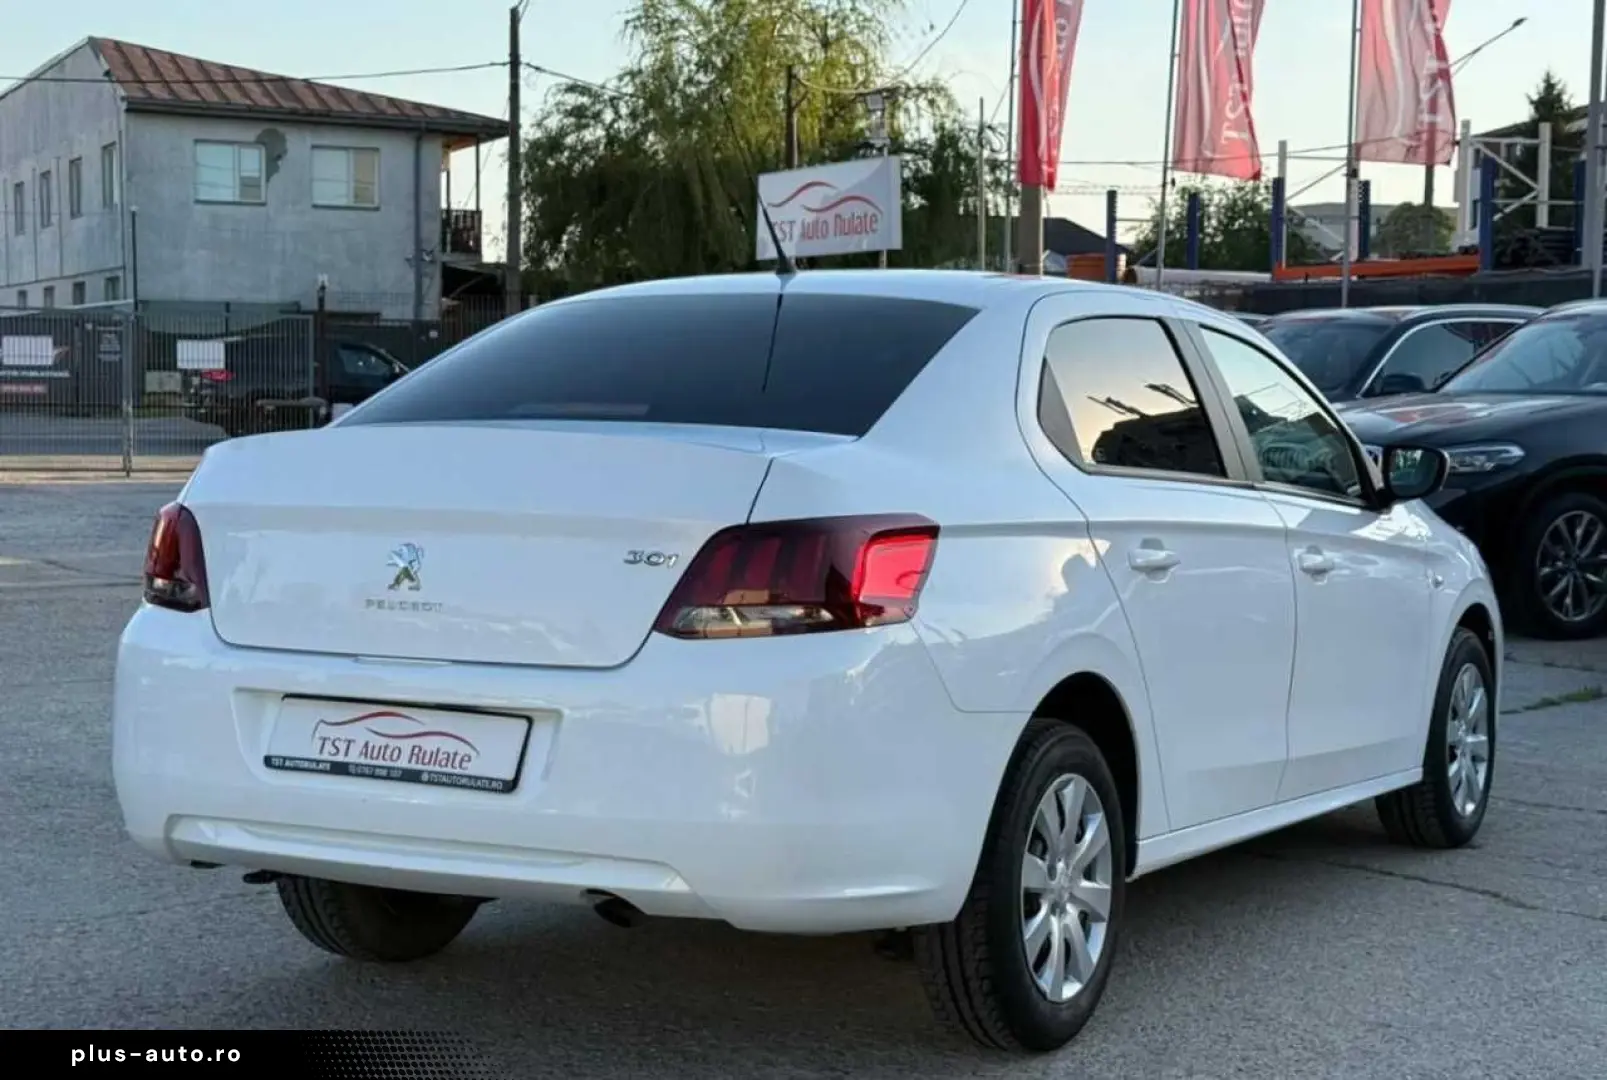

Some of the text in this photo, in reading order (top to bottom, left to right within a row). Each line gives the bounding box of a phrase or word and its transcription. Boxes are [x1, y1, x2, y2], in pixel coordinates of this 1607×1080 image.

[801, 217, 830, 241] Auto
[834, 212, 879, 237] Rulate
[623, 549, 679, 569] 301
[365, 599, 443, 612] PEUGEOT
[318, 736, 473, 771] TST Auto Rulate
